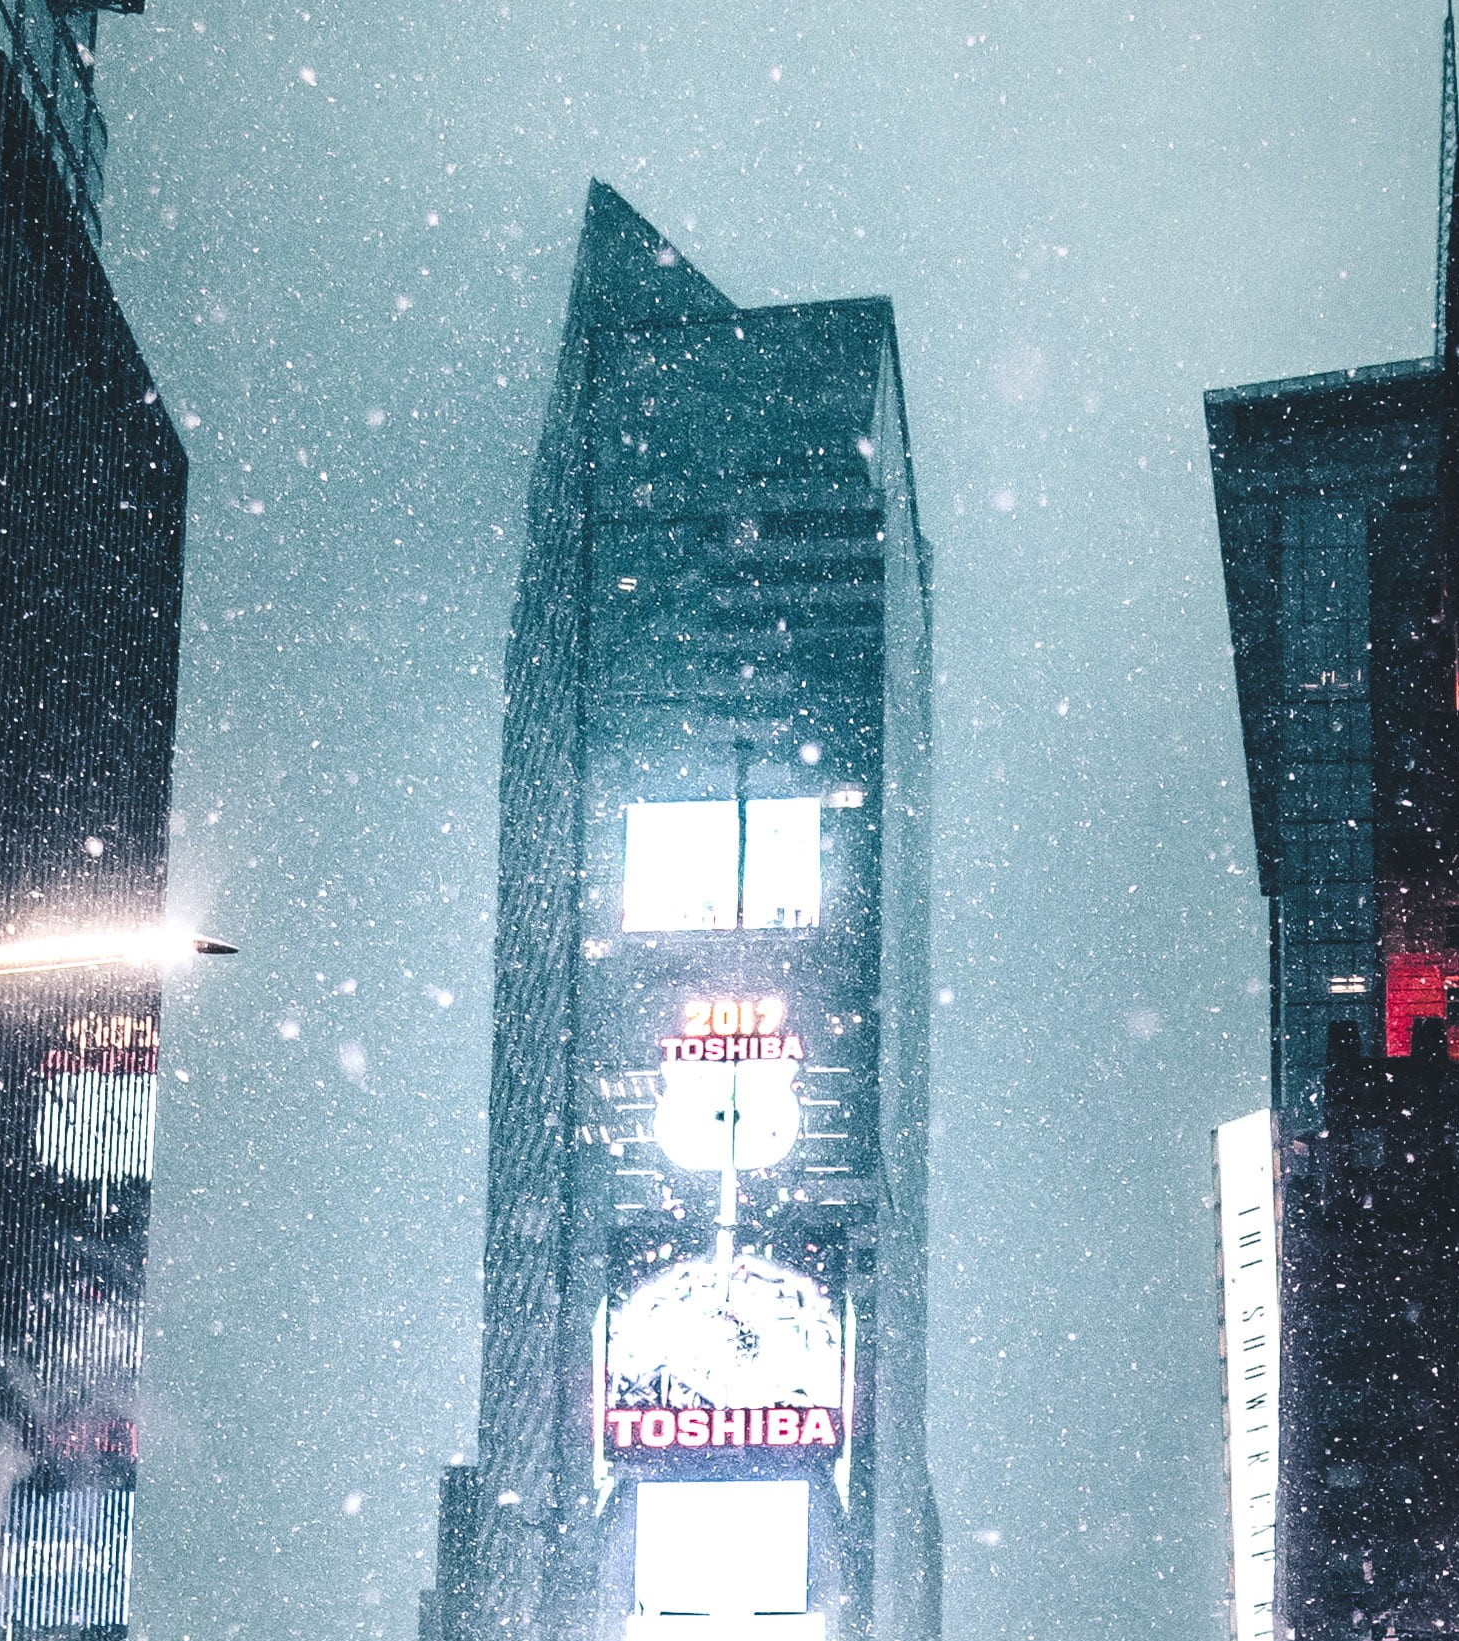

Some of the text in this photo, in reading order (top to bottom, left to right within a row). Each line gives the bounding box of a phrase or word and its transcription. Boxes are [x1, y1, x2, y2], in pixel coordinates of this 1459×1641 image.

[685, 1000, 784, 1036] 2017
[661, 1036, 804, 1061] TOSHIBA
[608, 1407, 836, 1450] TOSHIBA
